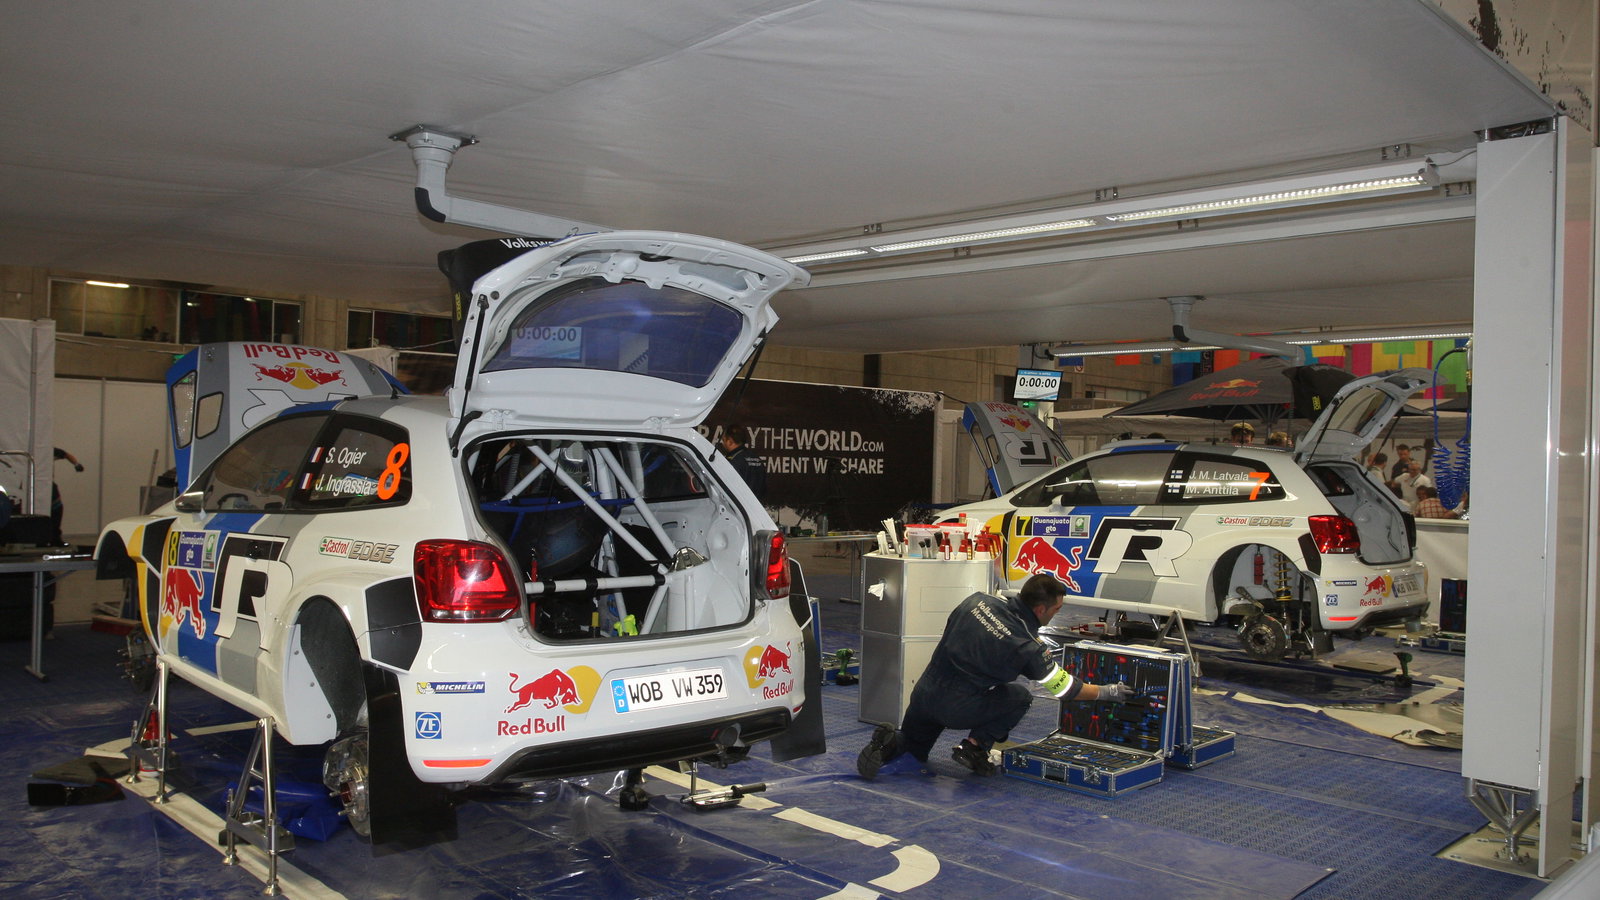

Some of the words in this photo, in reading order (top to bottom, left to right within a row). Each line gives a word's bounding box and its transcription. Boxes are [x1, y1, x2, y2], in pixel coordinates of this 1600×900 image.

[243, 344, 291, 359] Bull
[291, 346, 340, 364] Red
[1019, 377, 1057, 388] 0:00:00
[325, 446, 336, 464] S.
[338, 447, 367, 469] Ogier
[839, 457, 884, 474] SHARE
[377, 442, 410, 500] 8
[1188, 471, 1197, 480] J.
[1199, 471, 1210, 480] M.
[1213, 471, 1250, 481] Latvala
[314, 474, 325, 491] J.
[326, 474, 371, 497] Ingrassia
[1186, 486, 1200, 494] M.
[1202, 486, 1239, 495] Anttila
[1249, 471, 1270, 500] 7
[1019, 516, 1031, 536] 7
[1034, 517, 1070, 526] Guanajuato
[1045, 525, 1057, 533] gto
[1223, 517, 1248, 525] Castrol
[1248, 515, 1295, 527] EDGE
[169, 531, 179, 567] 8
[325, 540, 349, 555] Castrol
[348, 540, 400, 564] EDGE
[1360, 599, 1372, 607] Red
[1371, 598, 1383, 606] Bull
[970, 607, 1005, 640] Motorsport
[977, 600, 1012, 636] Volkswagen
[435, 683, 485, 691] MICHELIN
[628, 680, 664, 705] WOB
[671, 678, 693, 698] VW
[695, 673, 723, 695] 359
[762, 682, 780, 700] Red
[780, 678, 795, 696] Bull
[418, 717, 438, 733] ZF
[497, 717, 532, 737] Red
[534, 715, 566, 734] Bull
